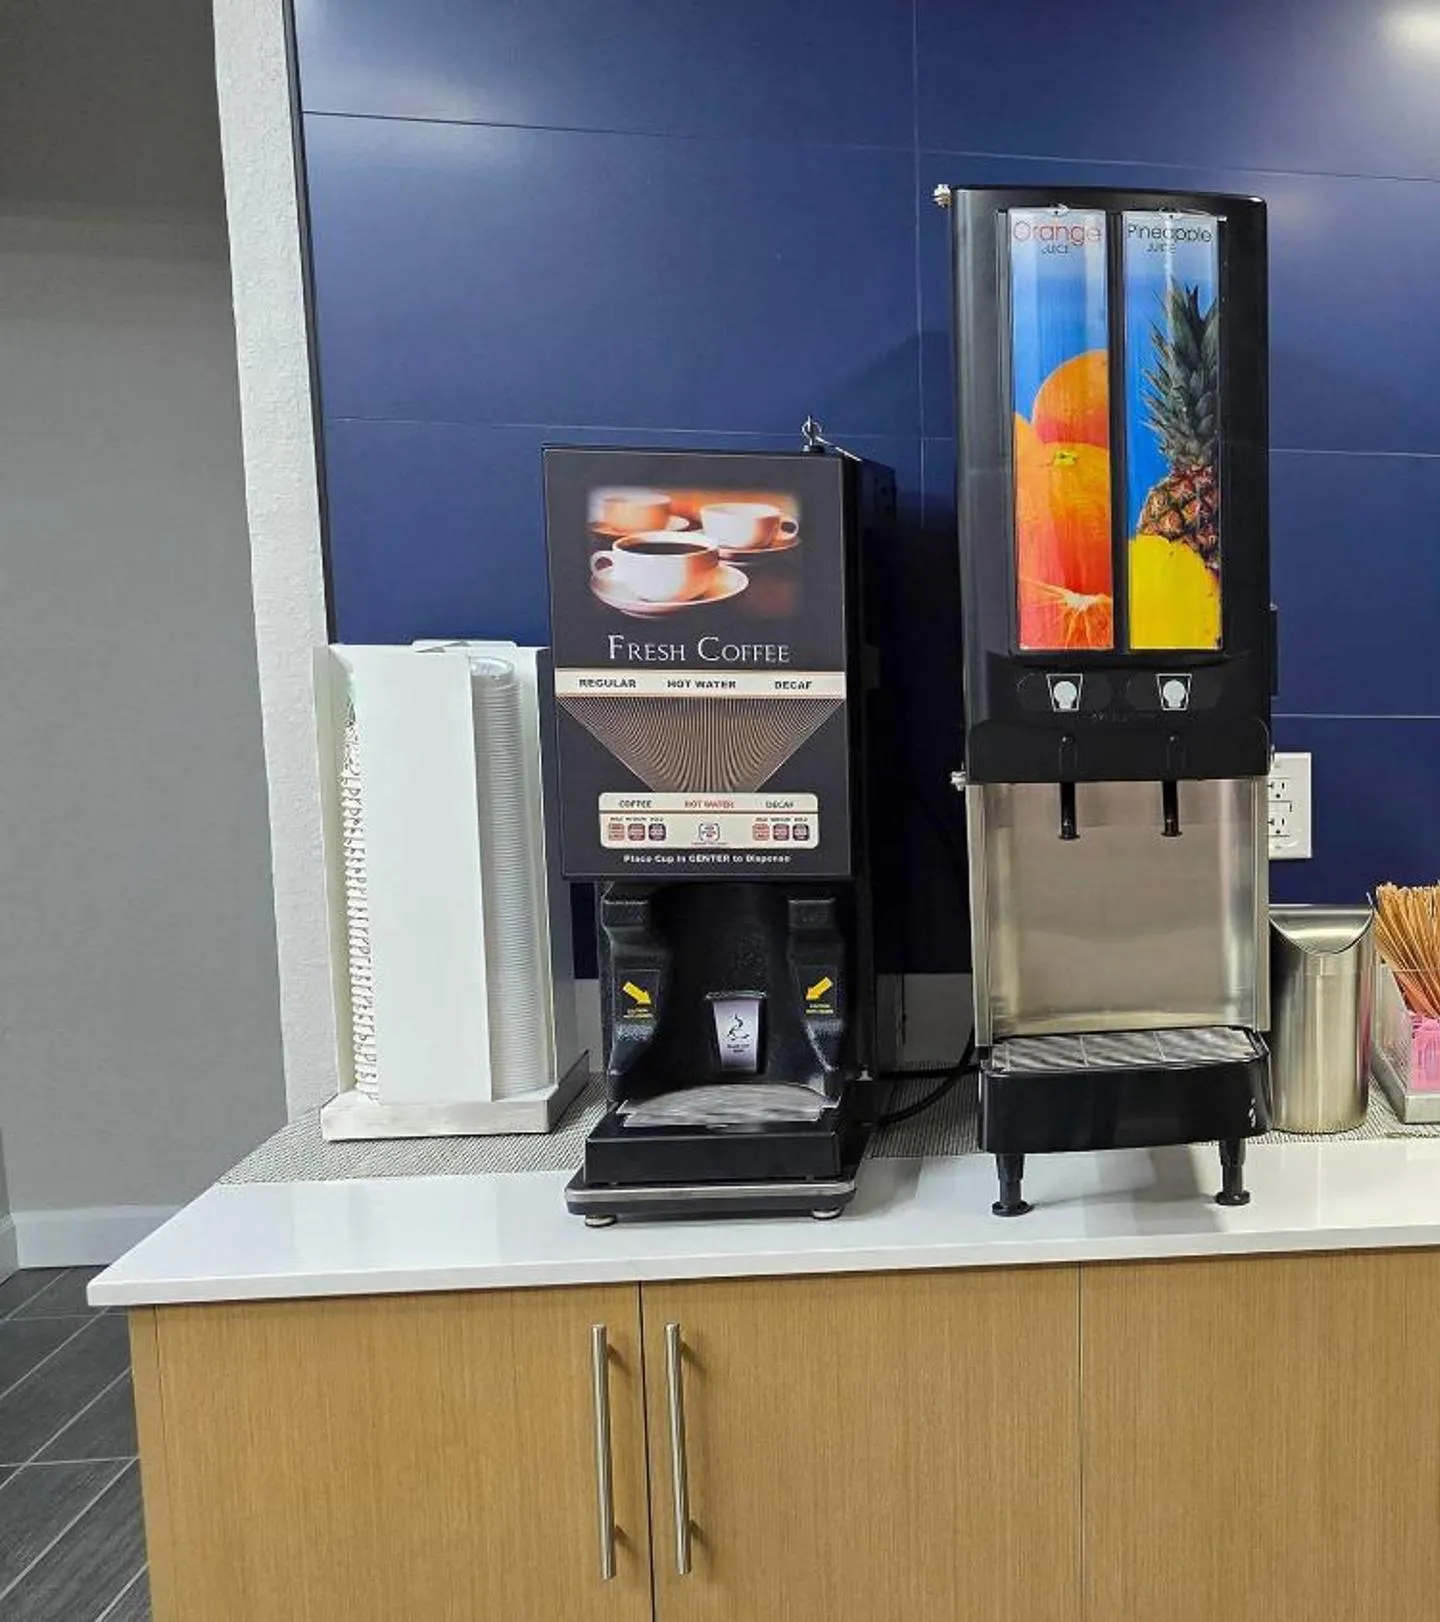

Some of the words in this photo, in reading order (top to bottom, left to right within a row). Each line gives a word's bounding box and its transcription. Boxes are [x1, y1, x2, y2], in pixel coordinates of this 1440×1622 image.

[1013, 220, 1102, 246] Orange
[1127, 222, 1213, 245] Pineapple
[578, 678, 637, 689] REGULAR
[667, 679, 695, 689] HOT
[696, 680, 736, 690] WATER
[775, 680, 813, 690] DECAF
[618, 800, 652, 809] COFFEE
[685, 800, 702, 809] HOT
[703, 801, 735, 809] WATER
[765, 800, 795, 809] DECAF
[623, 854, 652, 863] Place
[654, 854, 675, 865] Cup
[688, 854, 730, 863] CENTER
[732, 855, 744, 863] to
[745, 854, 792, 864] Dispense
